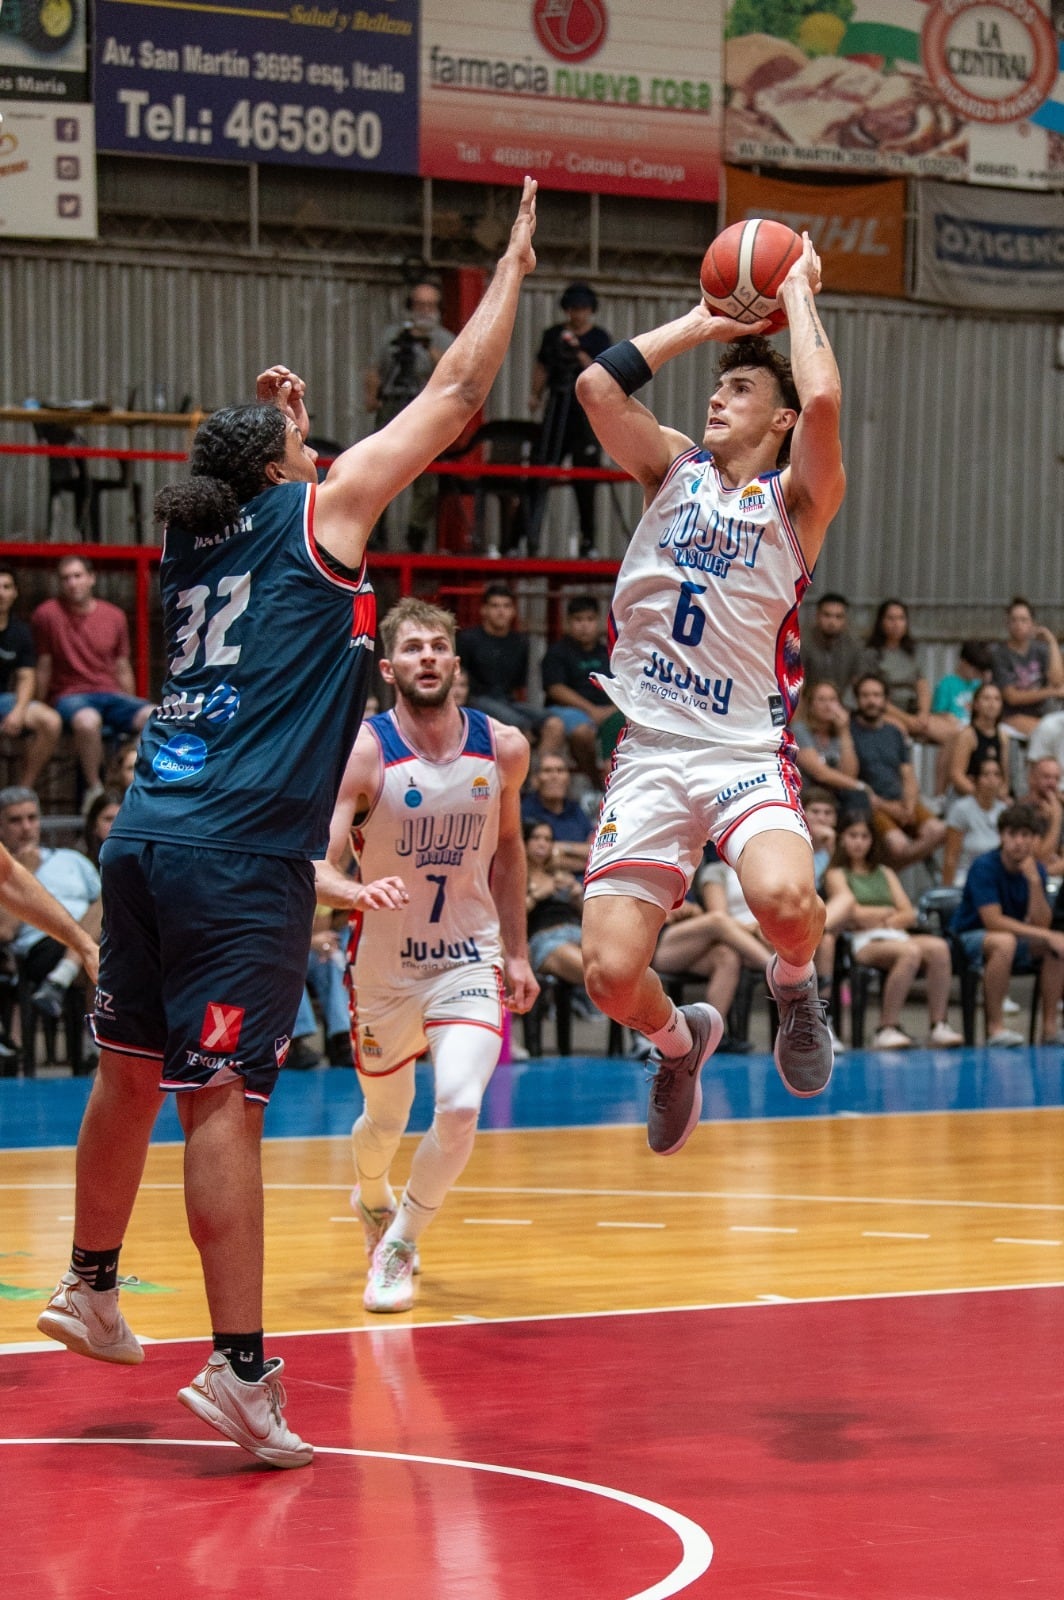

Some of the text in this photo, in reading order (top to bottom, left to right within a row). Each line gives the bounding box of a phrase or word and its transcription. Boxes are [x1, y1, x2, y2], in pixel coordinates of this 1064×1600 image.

[289, 4, 338, 27] Salud
[333, 14, 349, 33] y
[976, 19, 1002, 49] LA
[102, 37, 135, 67] Av.
[139, 40, 178, 71] San
[253, 52, 303, 84] 3695
[306, 62, 348, 93] esq.
[352, 62, 405, 93] Italia
[430, 46, 712, 110] farmacia nueva rosa
[946, 46, 1029, 82] CENTRAL
[118, 89, 383, 159] Tel.: 465860
[659, 502, 766, 568] JUJUY
[169, 571, 251, 676] 32
[671, 581, 707, 647] 6
[681, 689, 708, 711] viva
[159, 760, 195, 772] CAROYA
[395, 813, 487, 857] JUJUY
[426, 873, 448, 923] 7
